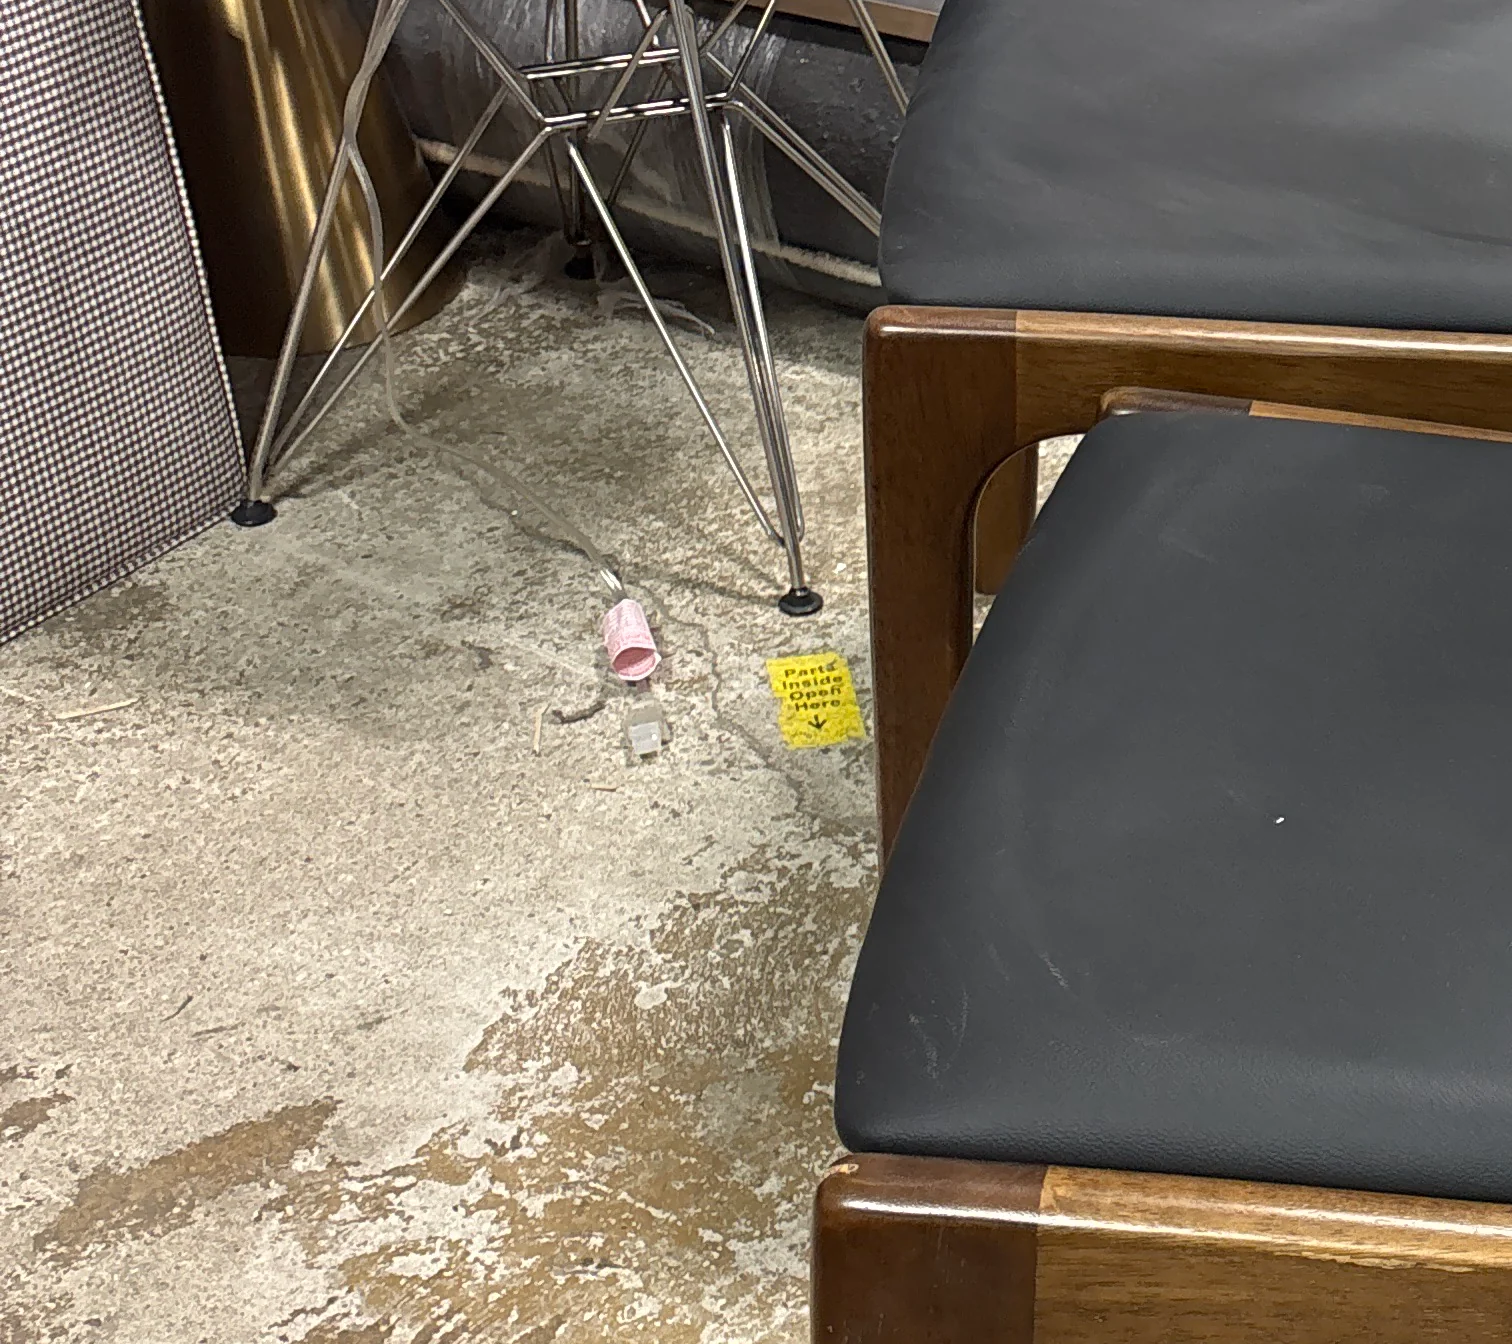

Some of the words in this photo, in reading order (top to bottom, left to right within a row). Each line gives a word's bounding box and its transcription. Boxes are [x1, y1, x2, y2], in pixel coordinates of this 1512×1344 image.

[782, 675, 843, 690] Inside
[789, 685, 841, 702] Open
[795, 699, 841, 712] Here
